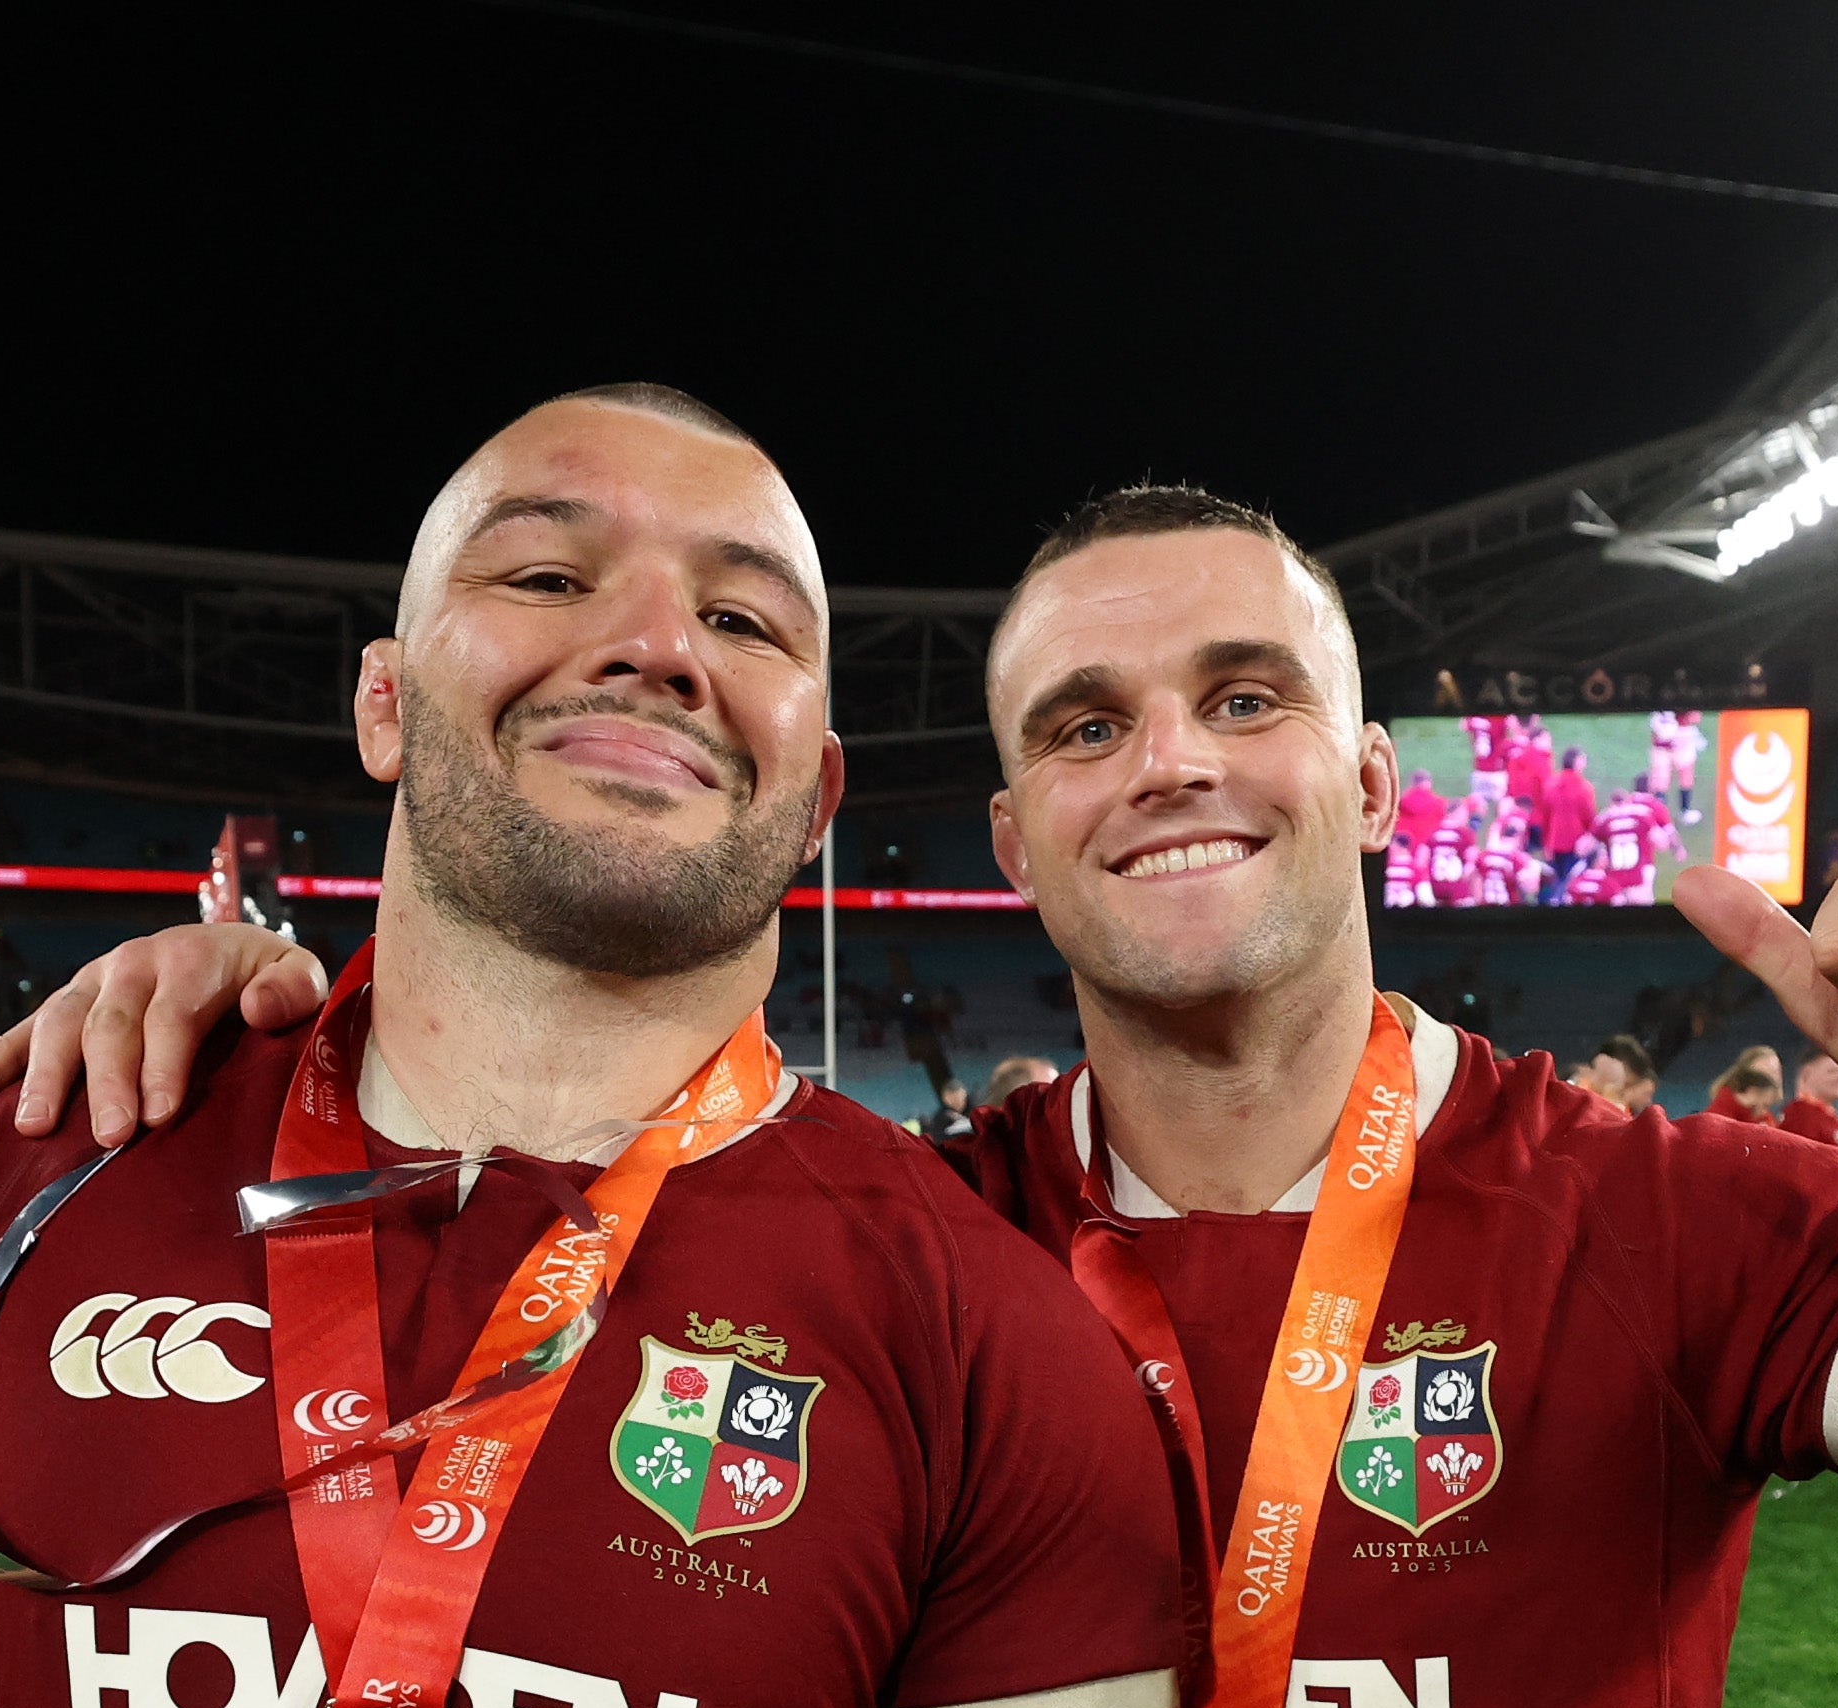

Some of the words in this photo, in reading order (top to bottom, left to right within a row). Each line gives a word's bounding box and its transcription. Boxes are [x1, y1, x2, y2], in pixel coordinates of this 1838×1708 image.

[697, 1085, 740, 1116] LIONS
[1347, 1084, 1400, 1190] QATAR
[1381, 1094, 1413, 1177] AIRWAYS
[1301, 1291, 1326, 1340] QATAR
[1325, 1296, 1350, 1345] LIONS
[320, 1444, 342, 1502] LINS
[437, 1435, 471, 1489] QATAR
[464, 1439, 500, 1496] LIONS
[606, 1534, 770, 1595] AUSTRALIA
[1237, 1500, 1285, 1616] QATAR
[1270, 1503, 1303, 1595] AIRWAYS
[1352, 1539, 1490, 1558] AUSTRALIA
[1391, 1560, 1452, 1573] 2025
[654, 1567, 725, 1599] 2025
